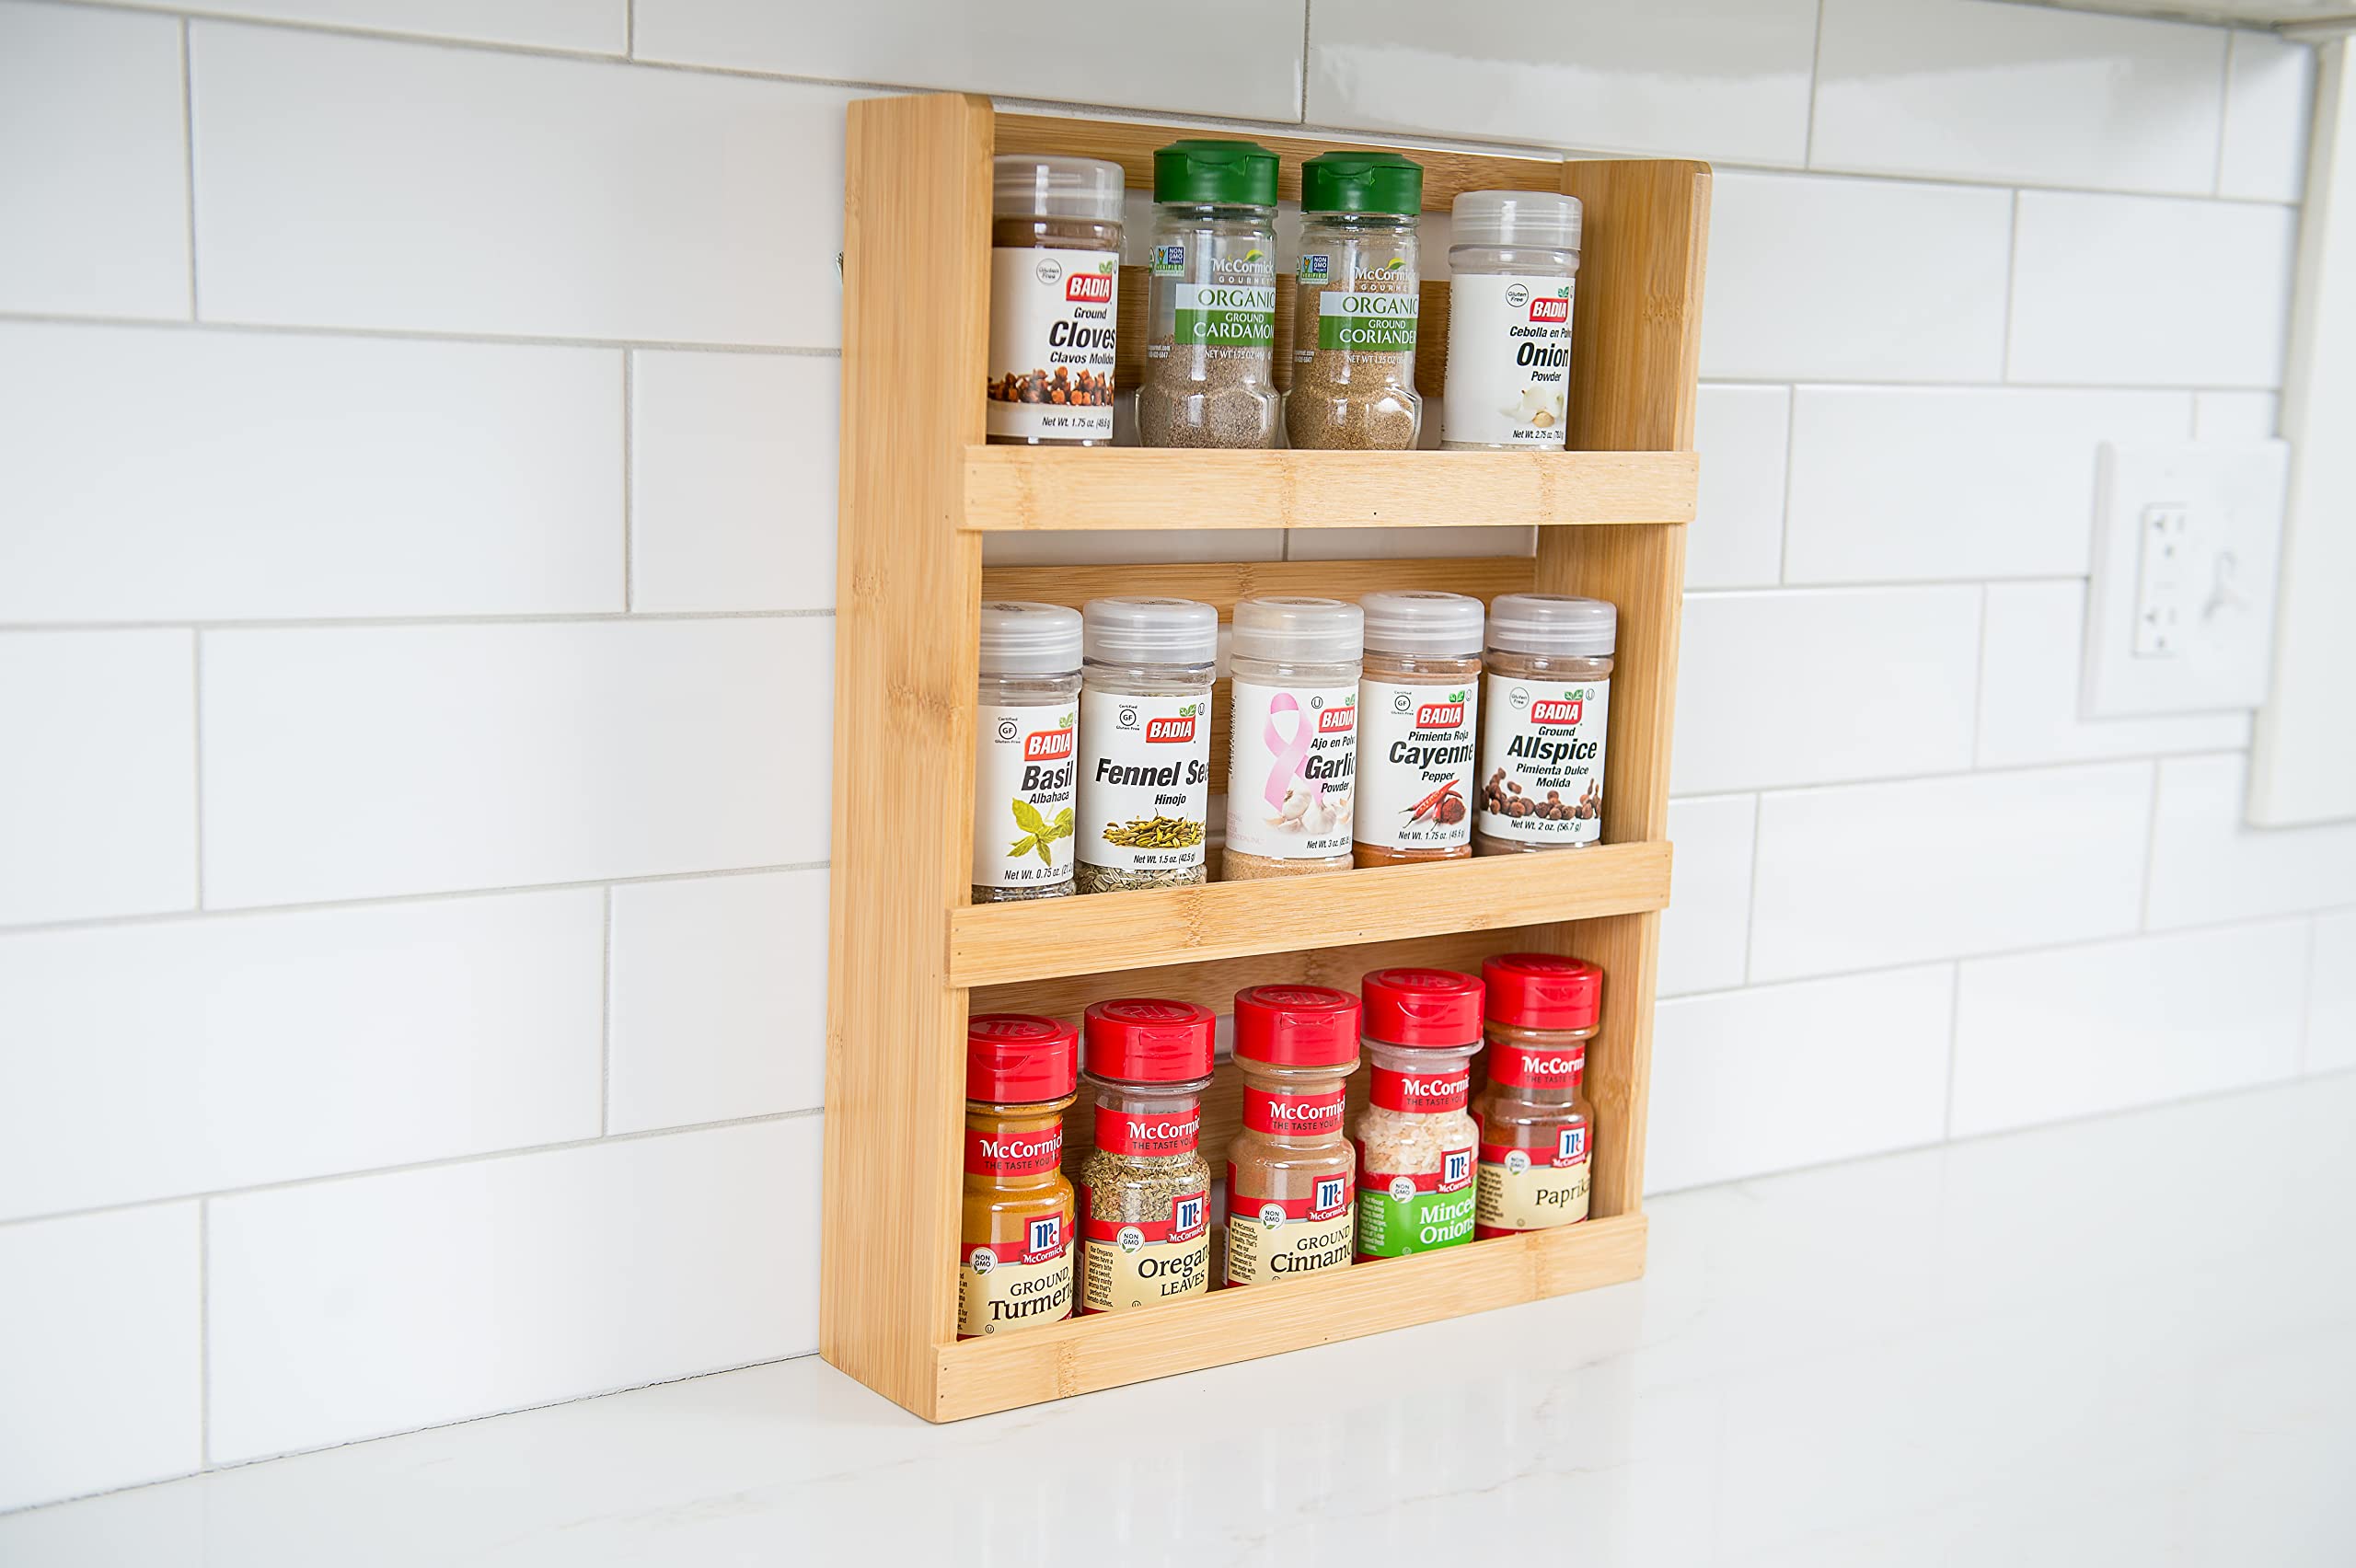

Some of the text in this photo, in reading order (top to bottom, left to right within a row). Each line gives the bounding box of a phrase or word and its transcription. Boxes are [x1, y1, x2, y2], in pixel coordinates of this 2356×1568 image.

[1219, 276, 1270, 284] GOURMET
[1069, 277, 1110, 297] BADIA
[1361, 283, 1408, 292] GOURME
[1198, 288, 1275, 309] ORGANIC
[1343, 296, 1417, 315] ORGANIC
[1532, 301, 1566, 317] BADIA
[1074, 306, 1107, 319] Ground
[1225, 313, 1264, 323] GROUND
[1369, 318, 1406, 329] GROUND
[1049, 321, 1115, 350] Cloves
[1509, 326, 1559, 338] Cebolla en
[1050, 351, 1087, 363] Clavos
[1205, 350, 1218, 359] NET
[1220, 350, 1231, 359] WT
[1347, 355, 1360, 363] NET
[1362, 355, 1373, 364] WT
[1517, 341, 1569, 367] Onion
[1530, 371, 1561, 382] Powder
[1042, 417, 1056, 426] Net
[1071, 418, 1086, 427] 1.75
[1513, 430, 1524, 438] Net
[1322, 709, 1354, 728] BADIA
[1419, 707, 1461, 724] BADIA
[1534, 703, 1579, 721] BADIA
[1149, 721, 1193, 738] BADIA
[1538, 725, 1576, 737] Ground
[1311, 734, 1355, 751] Ajo en Polv
[1408, 730, 1469, 743] Pimienta Roja
[1028, 733, 1071, 755] BADIA
[1507, 734, 1598, 766] Allspice
[1389, 741, 1474, 769] Cayenne
[1021, 760, 1074, 791] Basil
[1095, 757, 1182, 787] Fennel
[1516, 763, 1589, 776] Pimienta Dulce
[1422, 771, 1455, 783] Pepper
[1535, 777, 1571, 788] Molida
[1321, 781, 1350, 793] Powder
[1029, 790, 1069, 804] Albahaca
[1154, 793, 1186, 806] Hinojo
[1510, 820, 1523, 828] Net
[1525, 820, 1536, 830] Wt.
[1538, 822, 1543, 830] 2
[1399, 831, 1411, 839] Net
[1412, 831, 1423, 840] Wt.
[1425, 831, 1439, 840] 1.75
[1307, 840, 1318, 848] Net
[1133, 855, 1146, 863] Net
[1160, 855, 1169, 863] 1.5
[1004, 870, 1019, 880] Net
[1022, 870, 1034, 880] Wt.
[1036, 868, 1052, 879] 0.75
[1426, 1098, 1449, 1106] TASTE
[1273, 1120, 1333, 1131] THE TASTE YOU
[1132, 1137, 1193, 1149] THE TASTE YOU
[985, 1157, 1050, 1170] THE TASTE YOU
[1310, 1204, 1346, 1221] McCormick
[1169, 1225, 1205, 1242] McCormick
[1297, 1225, 1350, 1251] GROUND
[1023, 1245, 1064, 1263] McCormick
[1138, 1244, 1209, 1278] Oregan
[1010, 1266, 1069, 1297] GROUND
[1161, 1269, 1205, 1297] LEAVES
